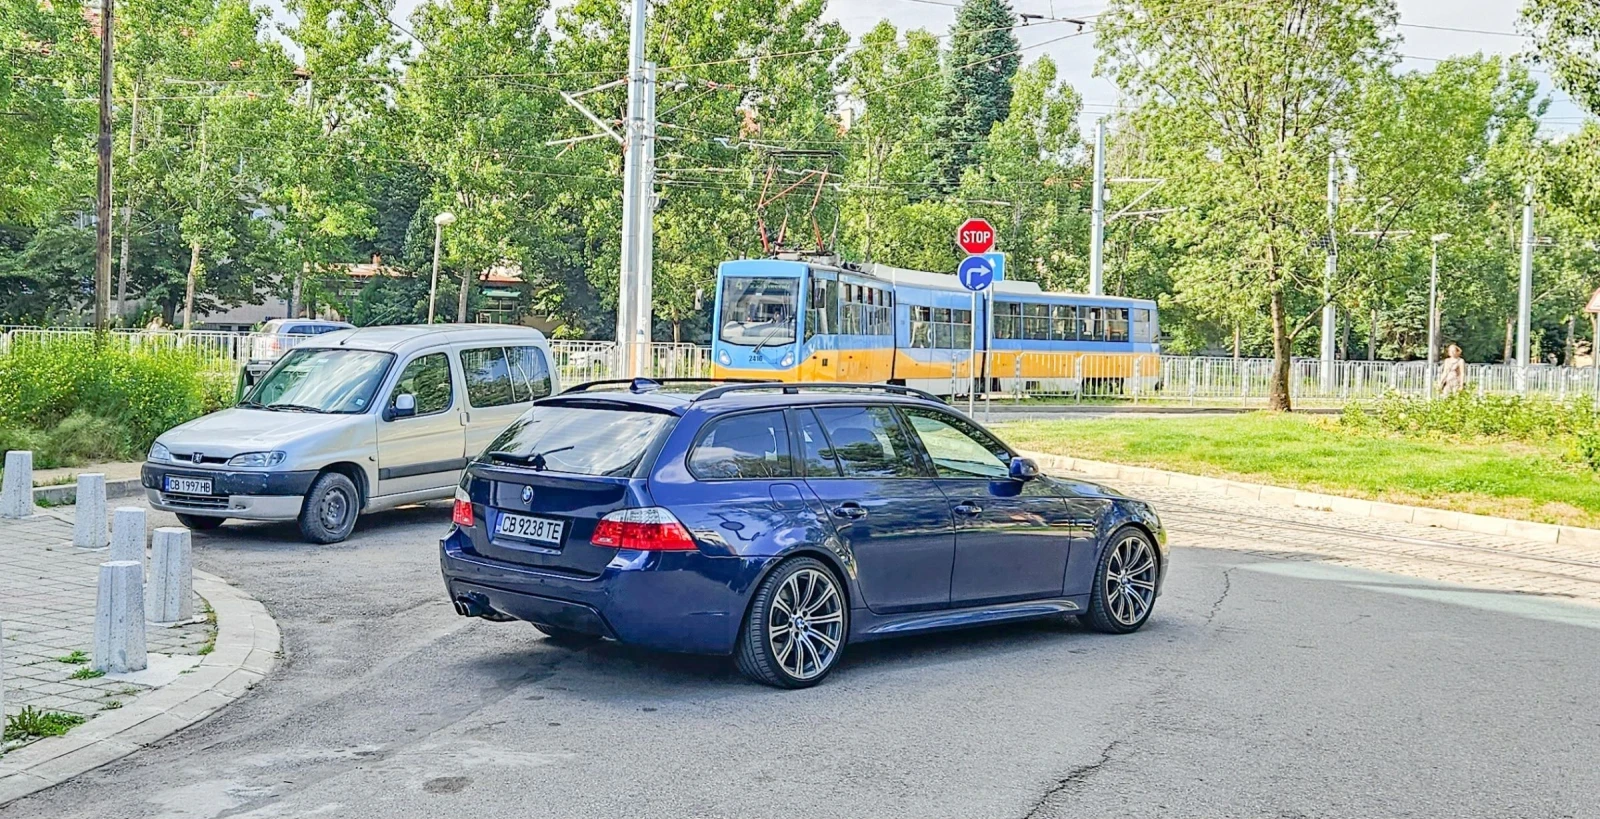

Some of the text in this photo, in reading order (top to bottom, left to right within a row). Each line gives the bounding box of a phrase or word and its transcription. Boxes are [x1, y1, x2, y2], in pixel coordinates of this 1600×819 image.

[962, 230, 991, 244] STOP
[735, 279, 743, 290] 4
[170, 479, 211, 493] CB 1997 HB
[502, 516, 561, 540] CB 9238 TE
